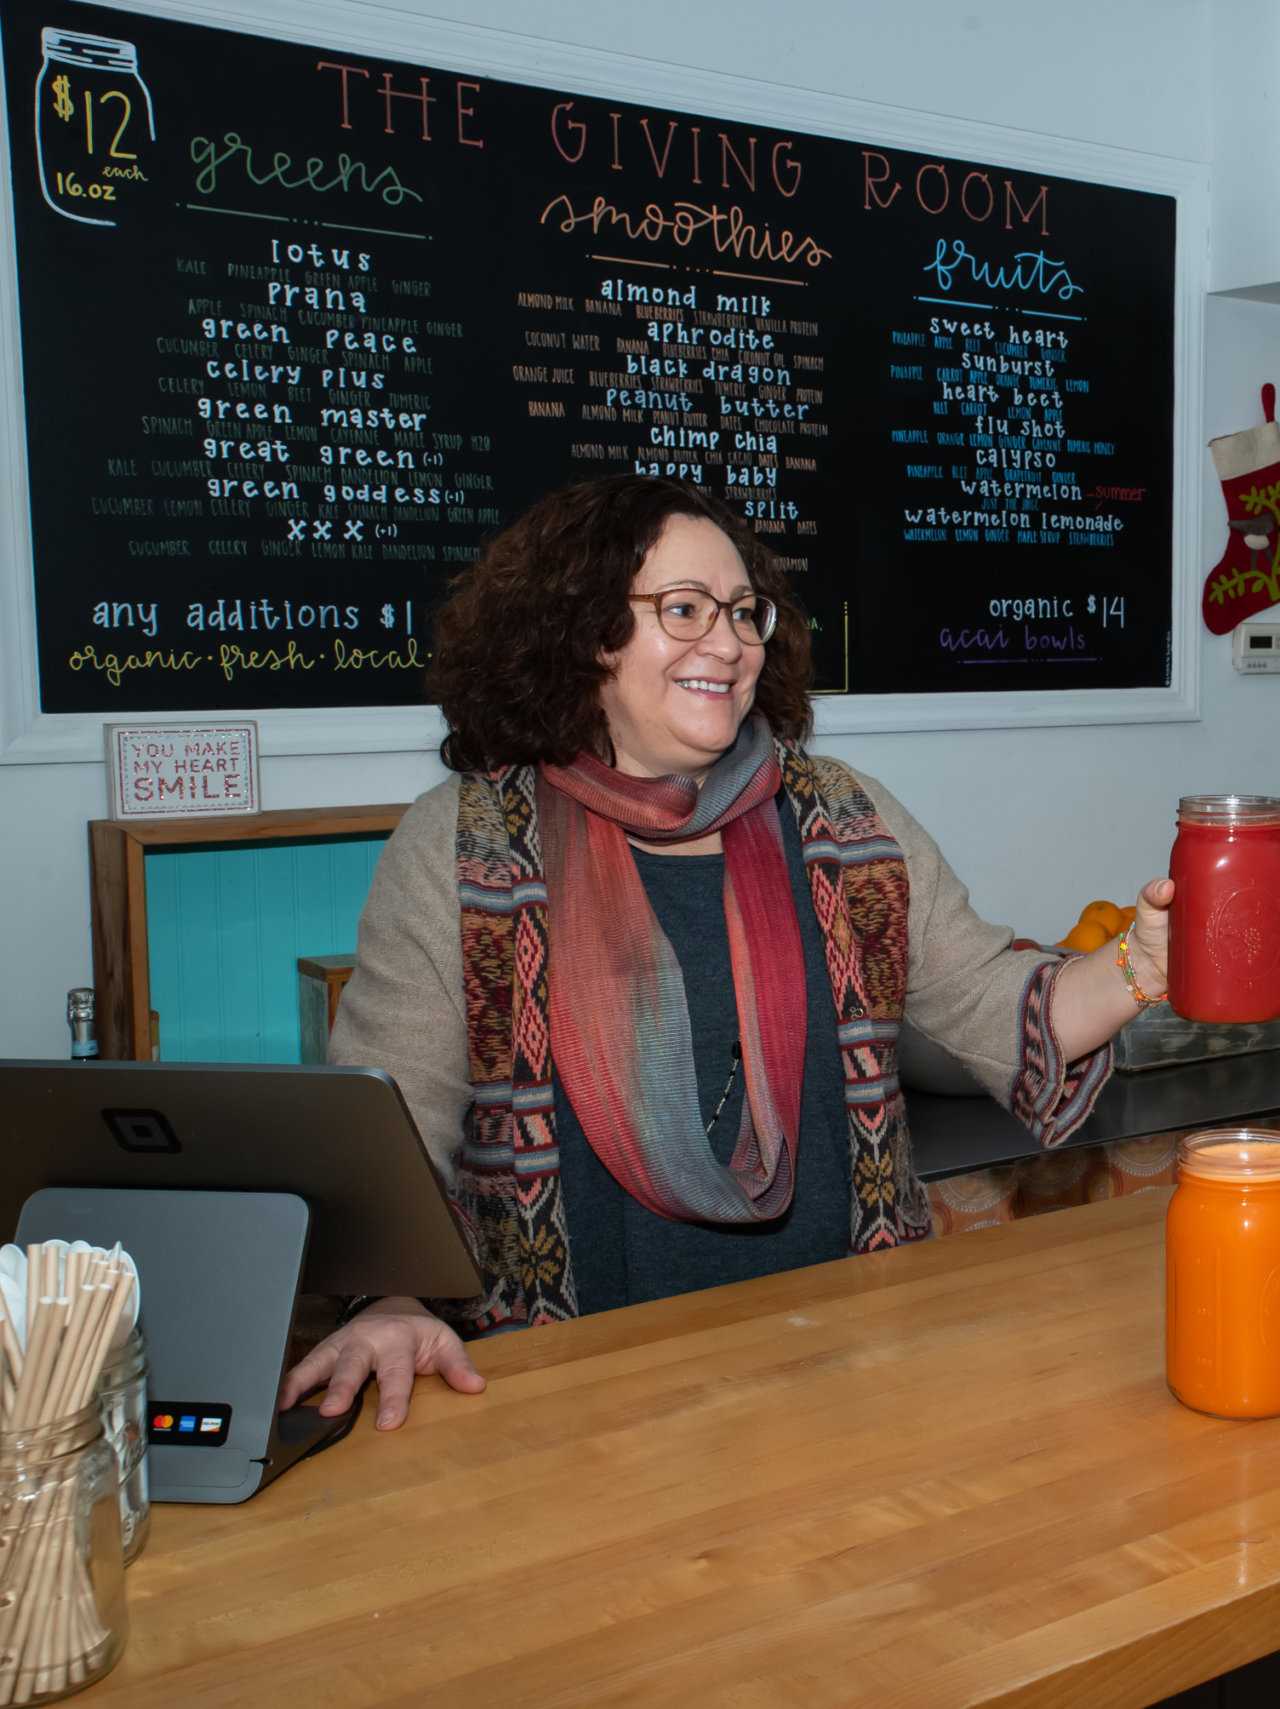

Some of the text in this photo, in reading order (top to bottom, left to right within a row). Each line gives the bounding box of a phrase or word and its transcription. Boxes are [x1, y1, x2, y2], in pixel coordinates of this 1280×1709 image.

[52, 75, 138, 160] $12
[317, 61, 1050, 236] THE GIVING ROOM
[102, 162, 149, 182] each
[190, 132, 423, 205] greens
[541, 194, 832, 267] smoothies
[271, 239, 371, 272] lotus
[922, 238, 1085, 301] fruits
[601, 278, 771, 318] almond milk
[201, 318, 290, 344] green
[929, 316, 1069, 350] sweet heart
[206, 359, 302, 386] celery
[626, 354, 791, 386] black dragon
[961, 352, 1055, 377] sunburst
[719, 396, 811, 421] butter
[942, 382, 1064, 408] heart beet
[197, 398, 428, 431] green master
[975, 415, 1066, 439] flu shot
[203, 437, 290, 463] great
[319, 445, 415, 470] green
[734, 430, 779, 454] chia
[976, 448, 1056, 470] calypso
[725, 464, 777, 488] baby
[960, 479, 1083, 501] watermelon
[207, 478, 299, 500] green
[323, 484, 441, 504] goddess
[904, 506, 1125, 532] watermelon lemonade
[92, 600, 158, 637] any
[186, 599, 360, 632] additions
[988, 594, 1126, 630] organic $14
[939, 623, 1086, 653] acai bowls
[132, 740, 241, 758] YOU MAKE
[133, 757, 239, 775] MY HEART
[133, 773, 241, 802] SMILE
